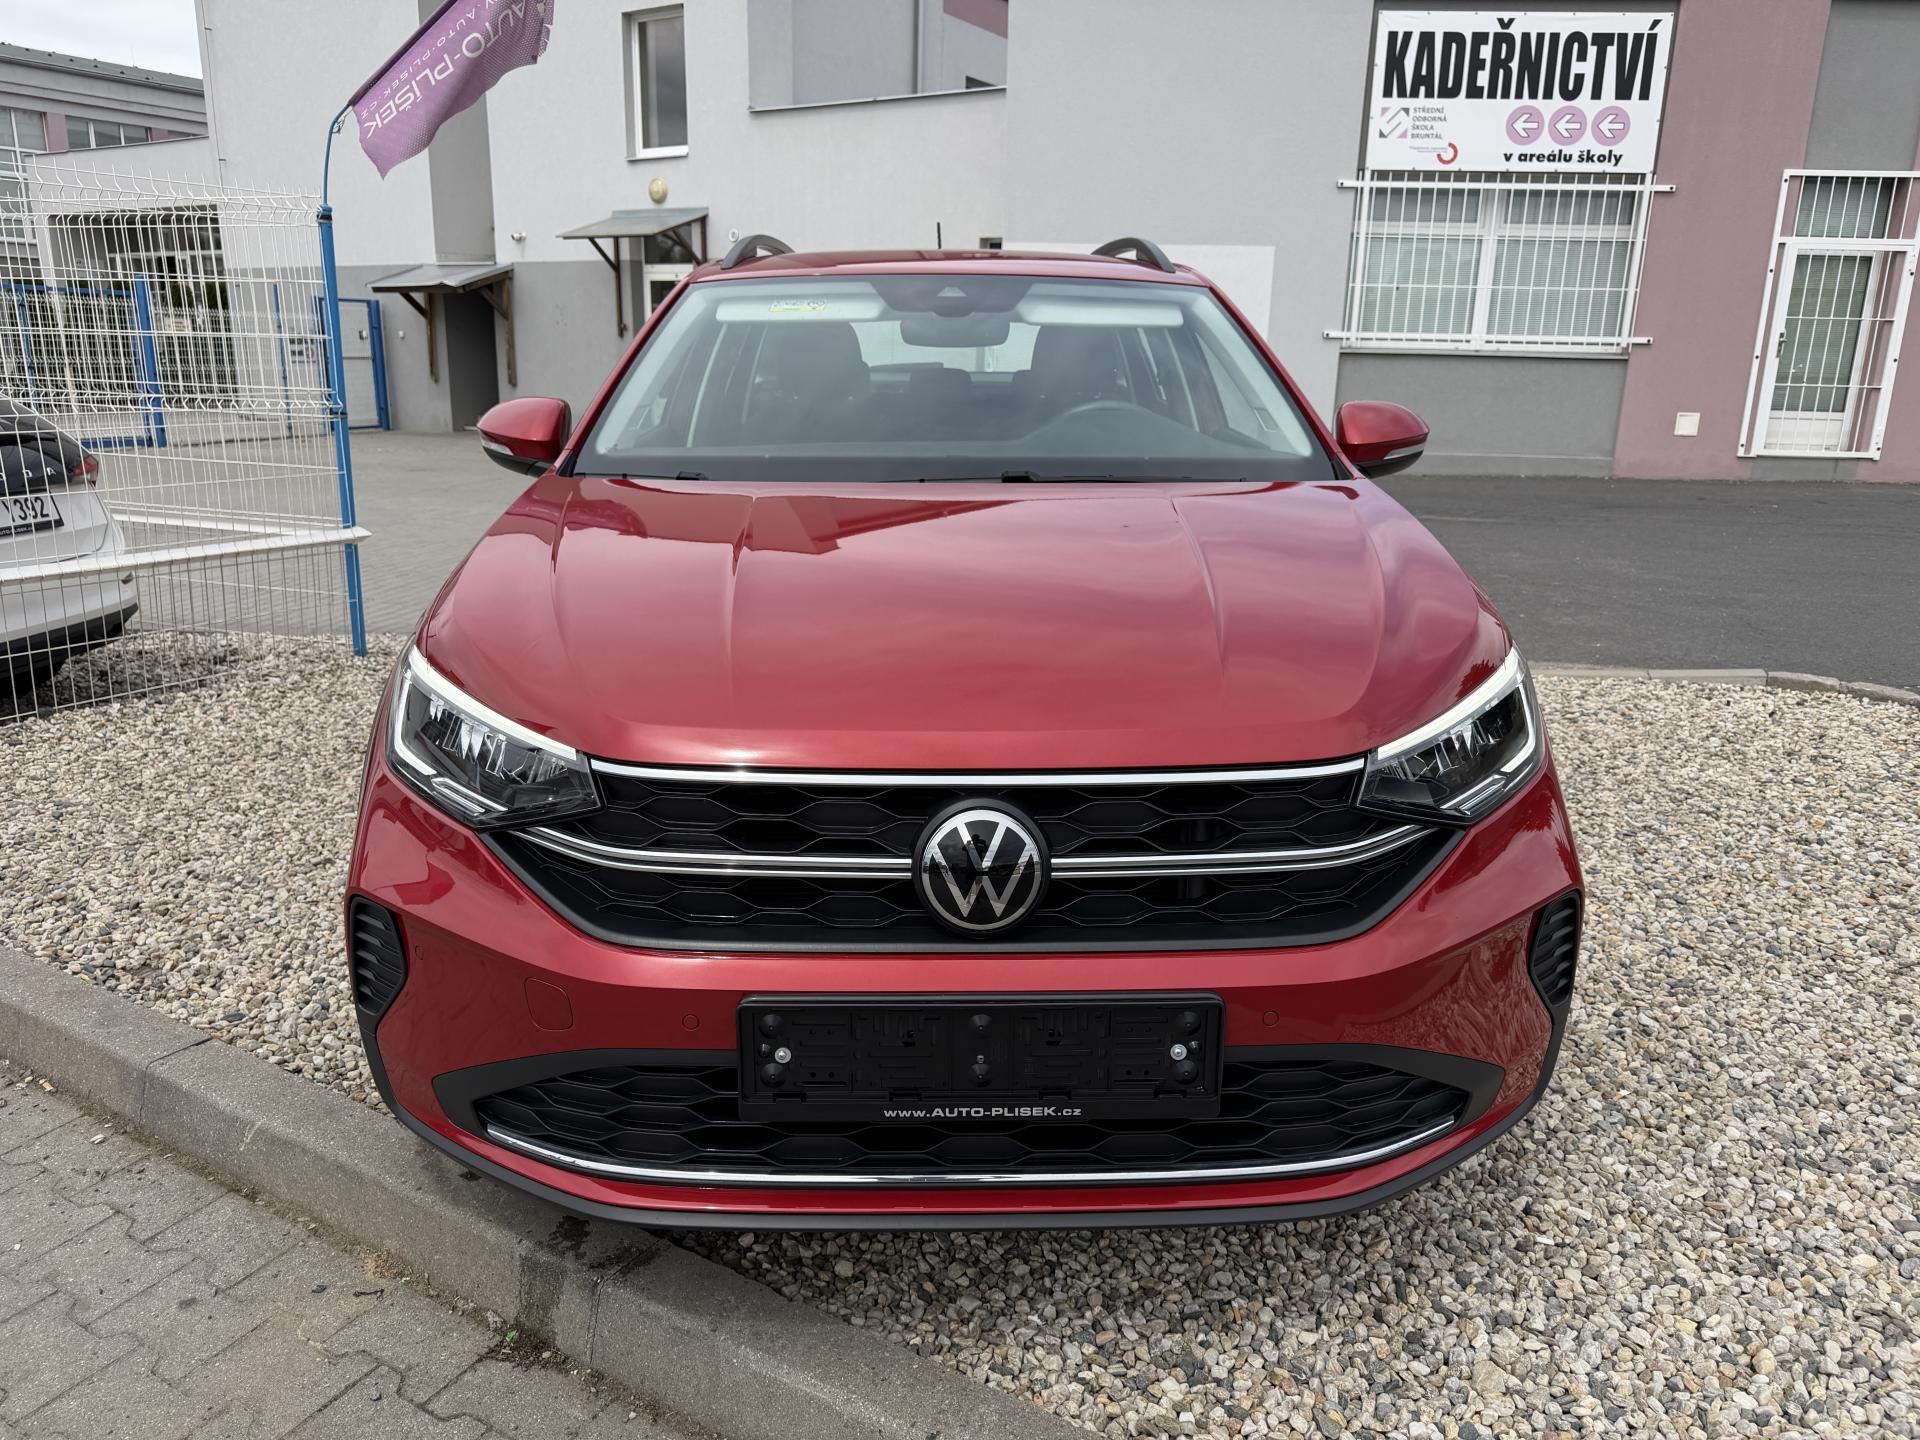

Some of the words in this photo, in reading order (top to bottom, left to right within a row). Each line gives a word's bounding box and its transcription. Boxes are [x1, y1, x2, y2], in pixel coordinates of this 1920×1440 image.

[1382, 18, 1662, 101] KADEŘNICTVÍ
[1413, 105, 1445, 114] STŘEDNÍ
[1412, 114, 1447, 122] ODBORNÁ
[1411, 122, 1434, 131] ŠKOLA
[1503, 151, 1513, 163] v
[1517, 149, 1573, 164] areálu
[1577, 149, 1623, 167] školy
[884, 1106, 1082, 1118] www.AUTO-PLISEK.cz
